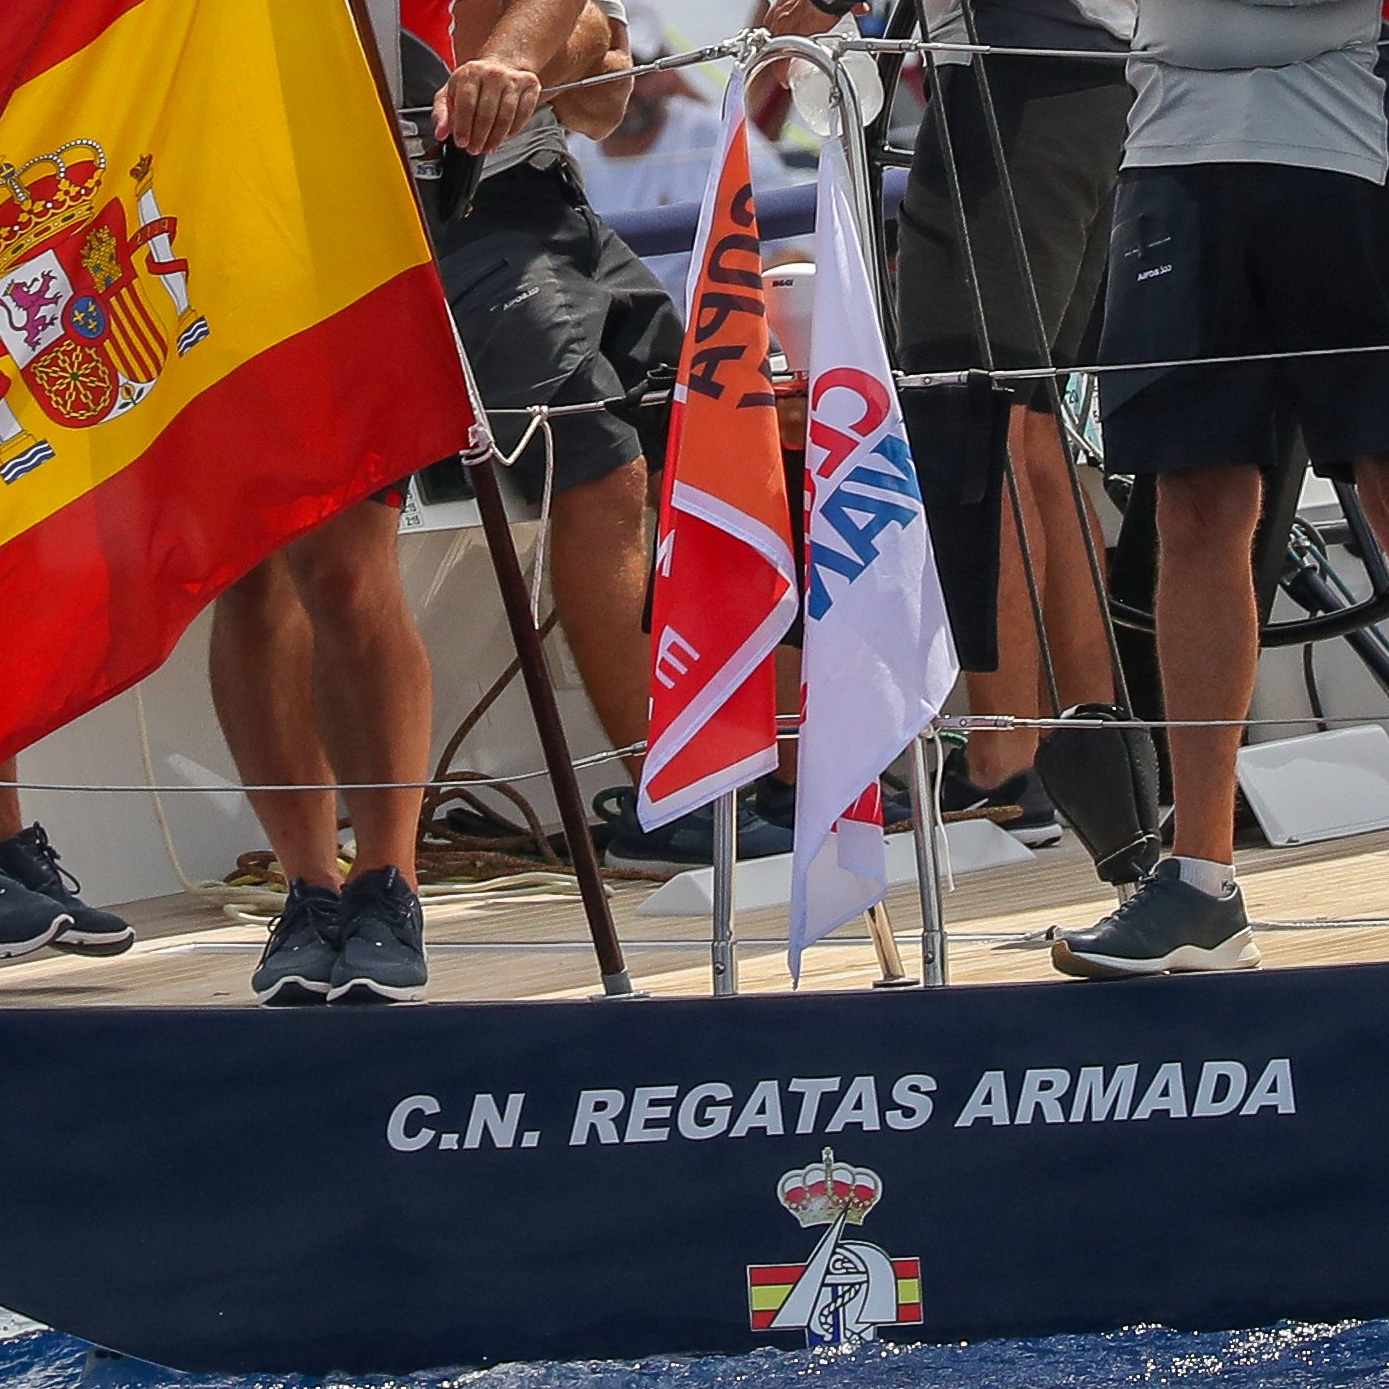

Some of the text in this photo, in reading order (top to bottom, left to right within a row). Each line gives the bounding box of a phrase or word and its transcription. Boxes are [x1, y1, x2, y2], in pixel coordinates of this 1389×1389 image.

[385, 1057, 1297, 1152] C.N. REGATAS ARMADA
